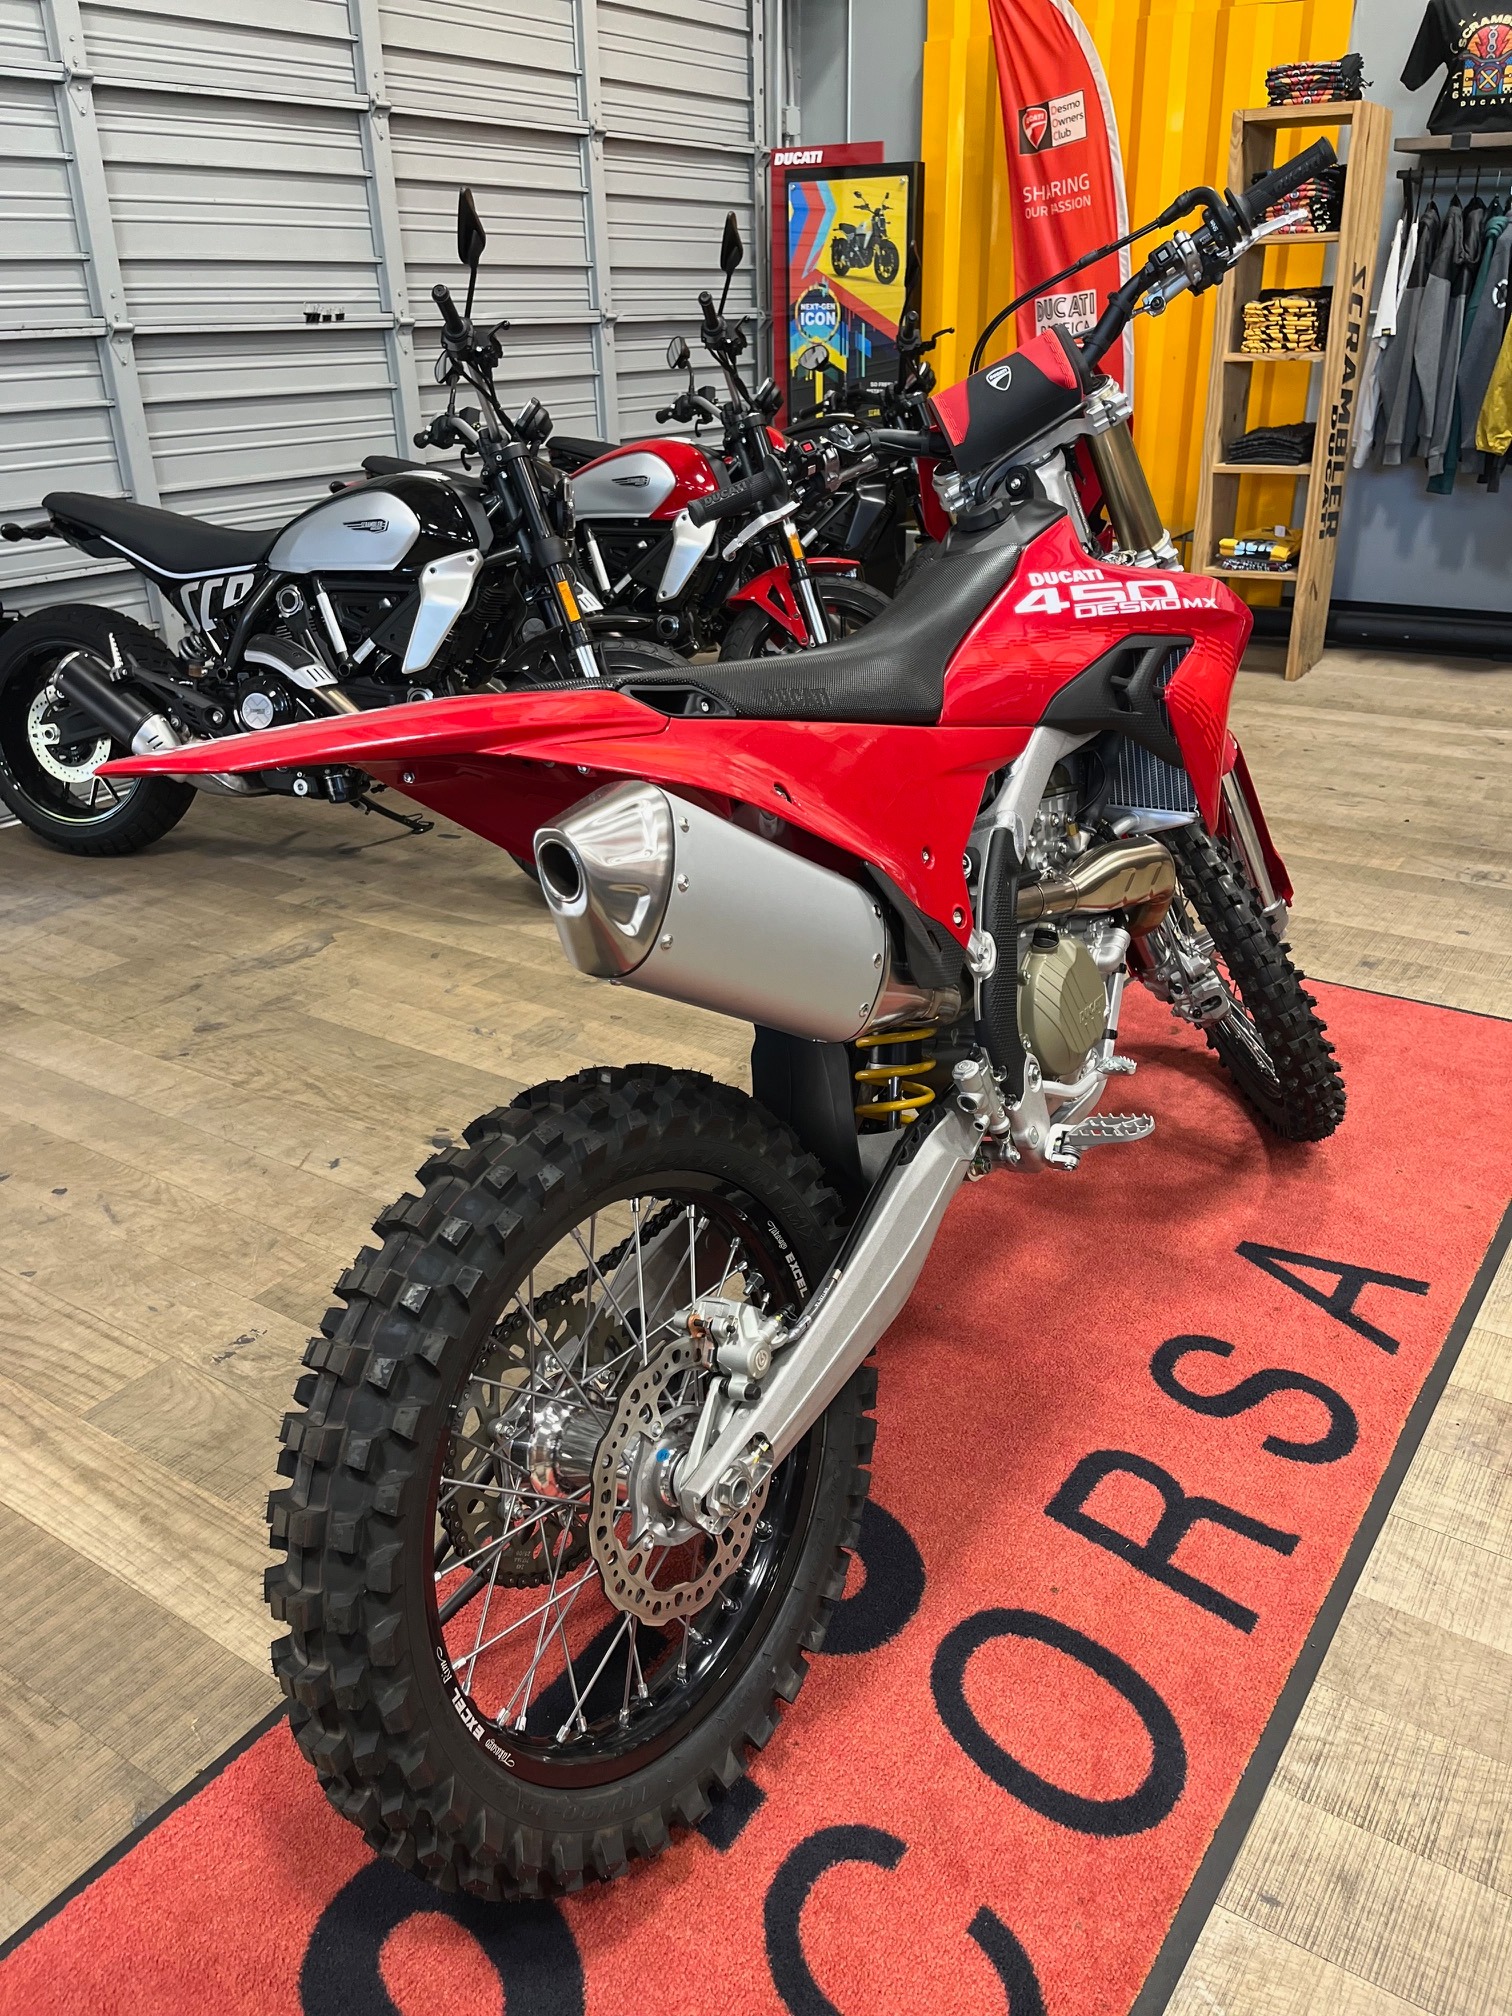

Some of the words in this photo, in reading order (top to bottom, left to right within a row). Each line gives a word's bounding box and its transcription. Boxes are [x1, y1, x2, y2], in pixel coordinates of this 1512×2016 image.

[1051, 100, 1081, 116] Desmo
[1052, 111, 1084, 128] Owners
[1053, 128, 1072, 141] Club
[774, 150, 823, 166] DUCATI
[1023, 173, 1090, 203] SHARING
[1025, 206, 1048, 219] OUR
[800, 303, 836, 311] NEXT-GEN
[800, 311, 836, 326] ICON
[1036, 292, 1095, 322] DUCATI
[1326, 261, 1366, 538] SCRAMBLER
[1319, 405, 1338, 539] DUCATI
[703, 481, 749, 508] DUCATI
[1028, 569, 1104, 587] DUCATI
[1014, 580, 1179, 615] 450
[1074, 598, 1181, 619] DESMO
[1184, 597, 1219, 609] MX
[785, 1251, 809, 1299] EXCEL
[764, 1240, 1431, 2016] CORSA
[436, 1645, 452, 1685] Rim
[452, 1686, 486, 1742] EXCEL
[484, 1738, 516, 1768] Takasago
